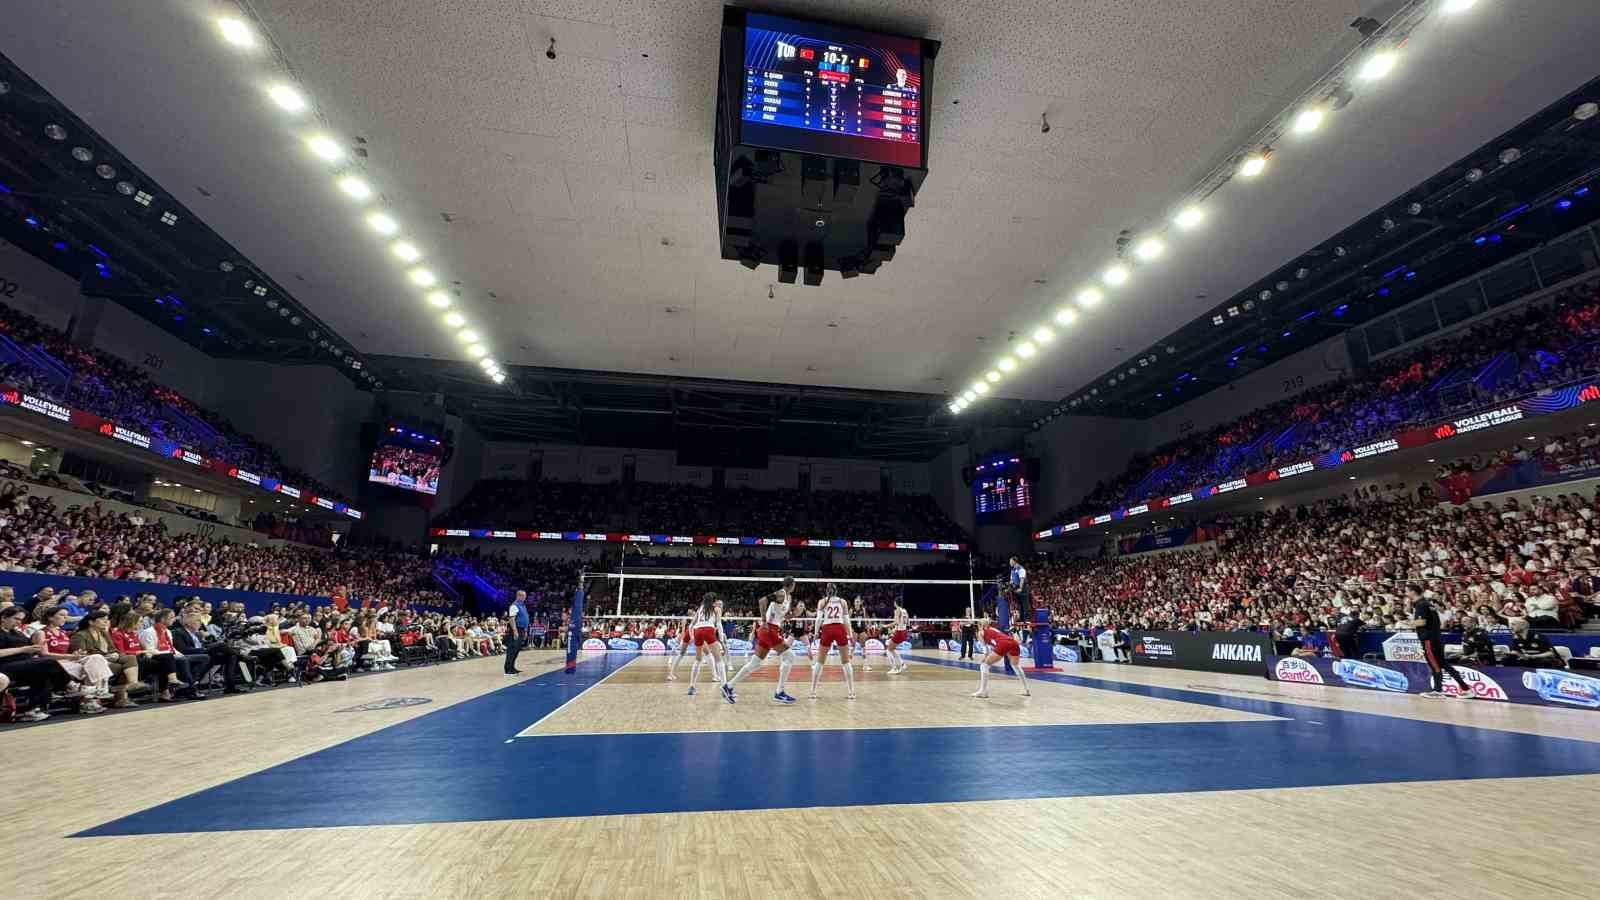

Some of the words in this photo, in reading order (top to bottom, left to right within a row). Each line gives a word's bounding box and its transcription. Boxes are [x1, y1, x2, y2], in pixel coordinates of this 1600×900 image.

[777, 41, 796, 58] TUR
[23, 394, 71, 416] VOLLEYBALL
[1454, 405, 1523, 428] VOLLEYBALL
[1456, 420, 1490, 434] NATIONS
[1491, 412, 1523, 426] LEAGUE
[115, 426, 151, 443] VOLLEYBALL
[1353, 438, 1399, 454] VOLLEYBALL
[827, 606, 840, 619] 22
[1212, 643, 1262, 662] ANKARA
